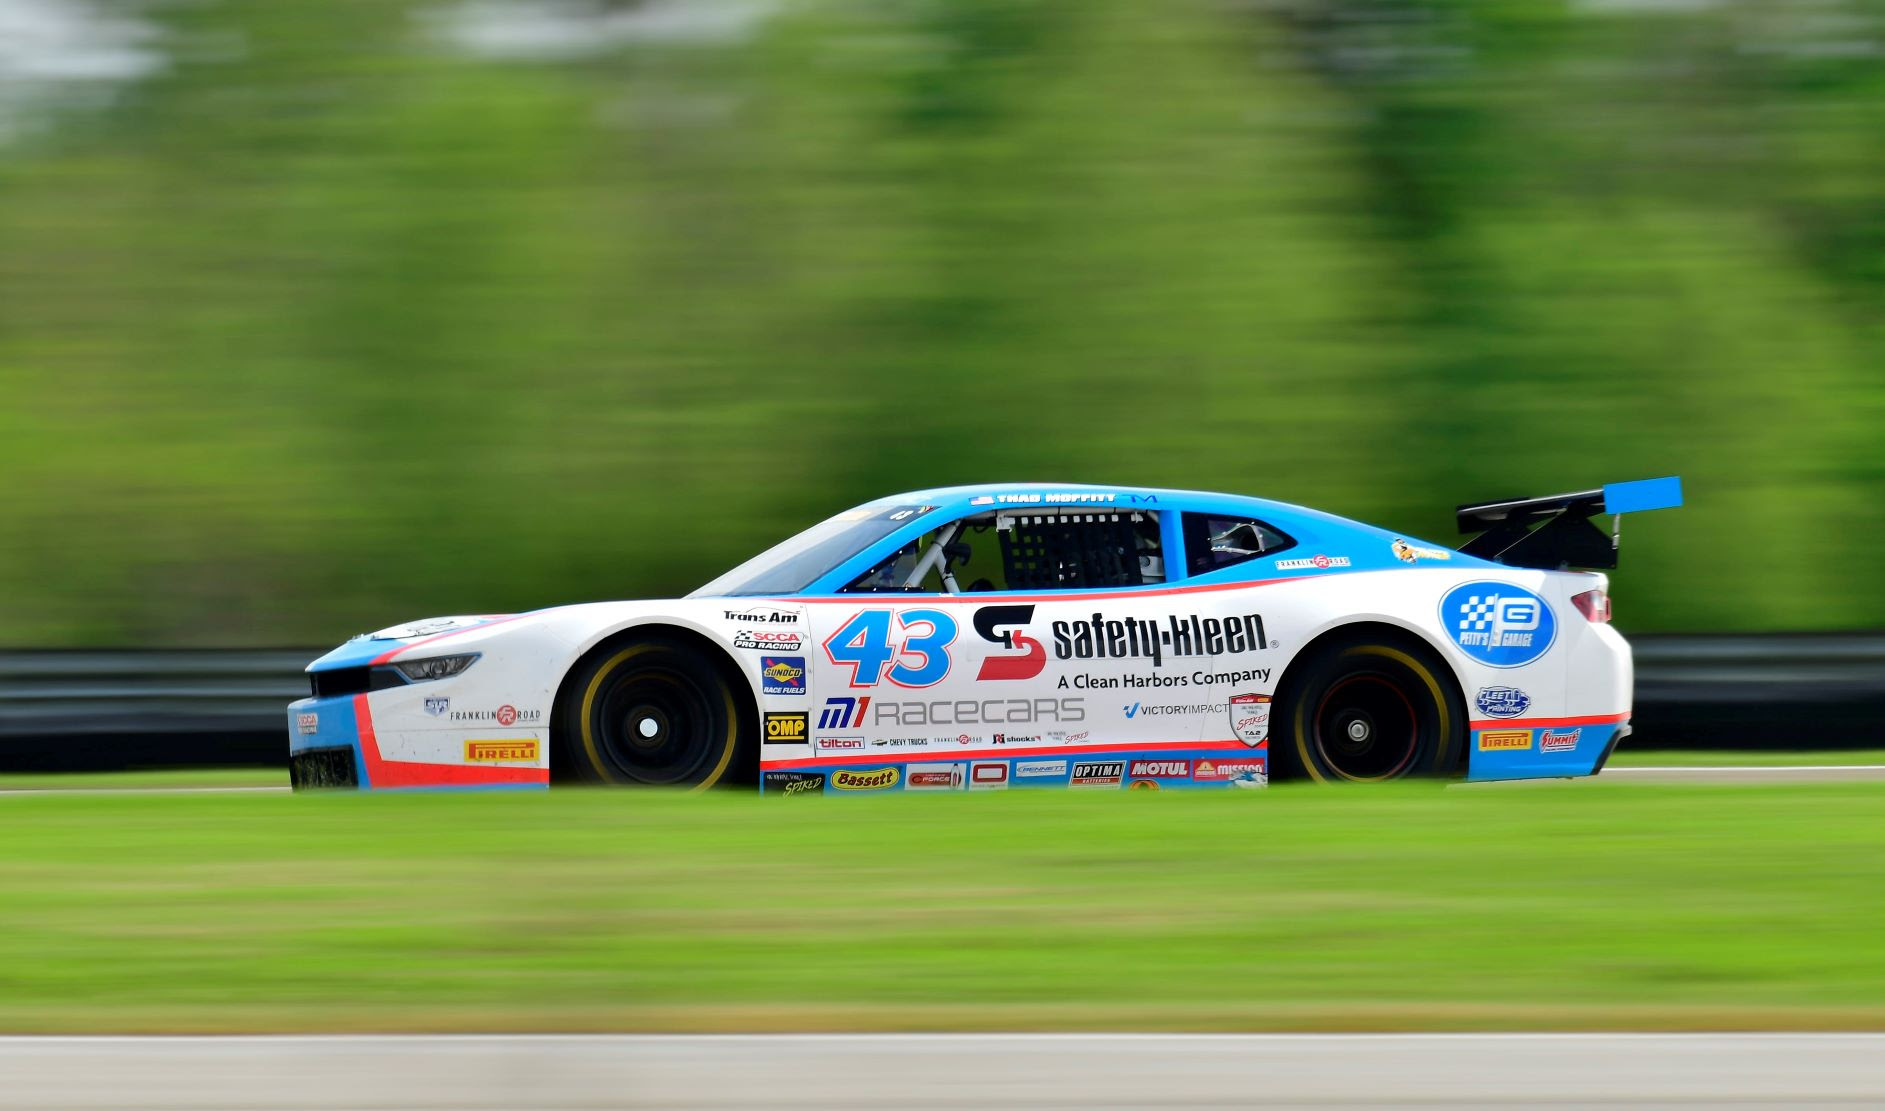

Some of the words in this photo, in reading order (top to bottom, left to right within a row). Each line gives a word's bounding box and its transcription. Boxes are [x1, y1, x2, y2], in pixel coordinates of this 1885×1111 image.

[997, 495, 1041, 503] THAD
[724, 611, 766, 622] Trans
[769, 612, 798, 623] Am
[753, 632, 800, 642] SCCA
[1502, 633, 1533, 647] GARAGE
[822, 608, 960, 689] 43
[765, 668, 801, 677] SUNOCO
[1057, 676, 1070, 689] A
[1074, 673, 1119, 689] Clean
[1124, 673, 1188, 688] Harbors
[1192, 668, 1272, 688] Company
[1480, 691, 1511, 700] FLEET
[450, 711, 497, 721] FRANKLIN
[517, 710, 541, 719] ROAD
[767, 720, 805, 736] OMP
[818, 738, 862, 748] tilton
[889, 738, 906, 746] CHEVY
[907, 737, 928, 746] TRUCKS
[1482, 732, 1529, 748] PIRELLI
[469, 743, 536, 759] PIRELLI
[1075, 764, 1121, 777] OPTIMA
[1131, 762, 1188, 775] MOTUL
[838, 771, 894, 787] Bassett
